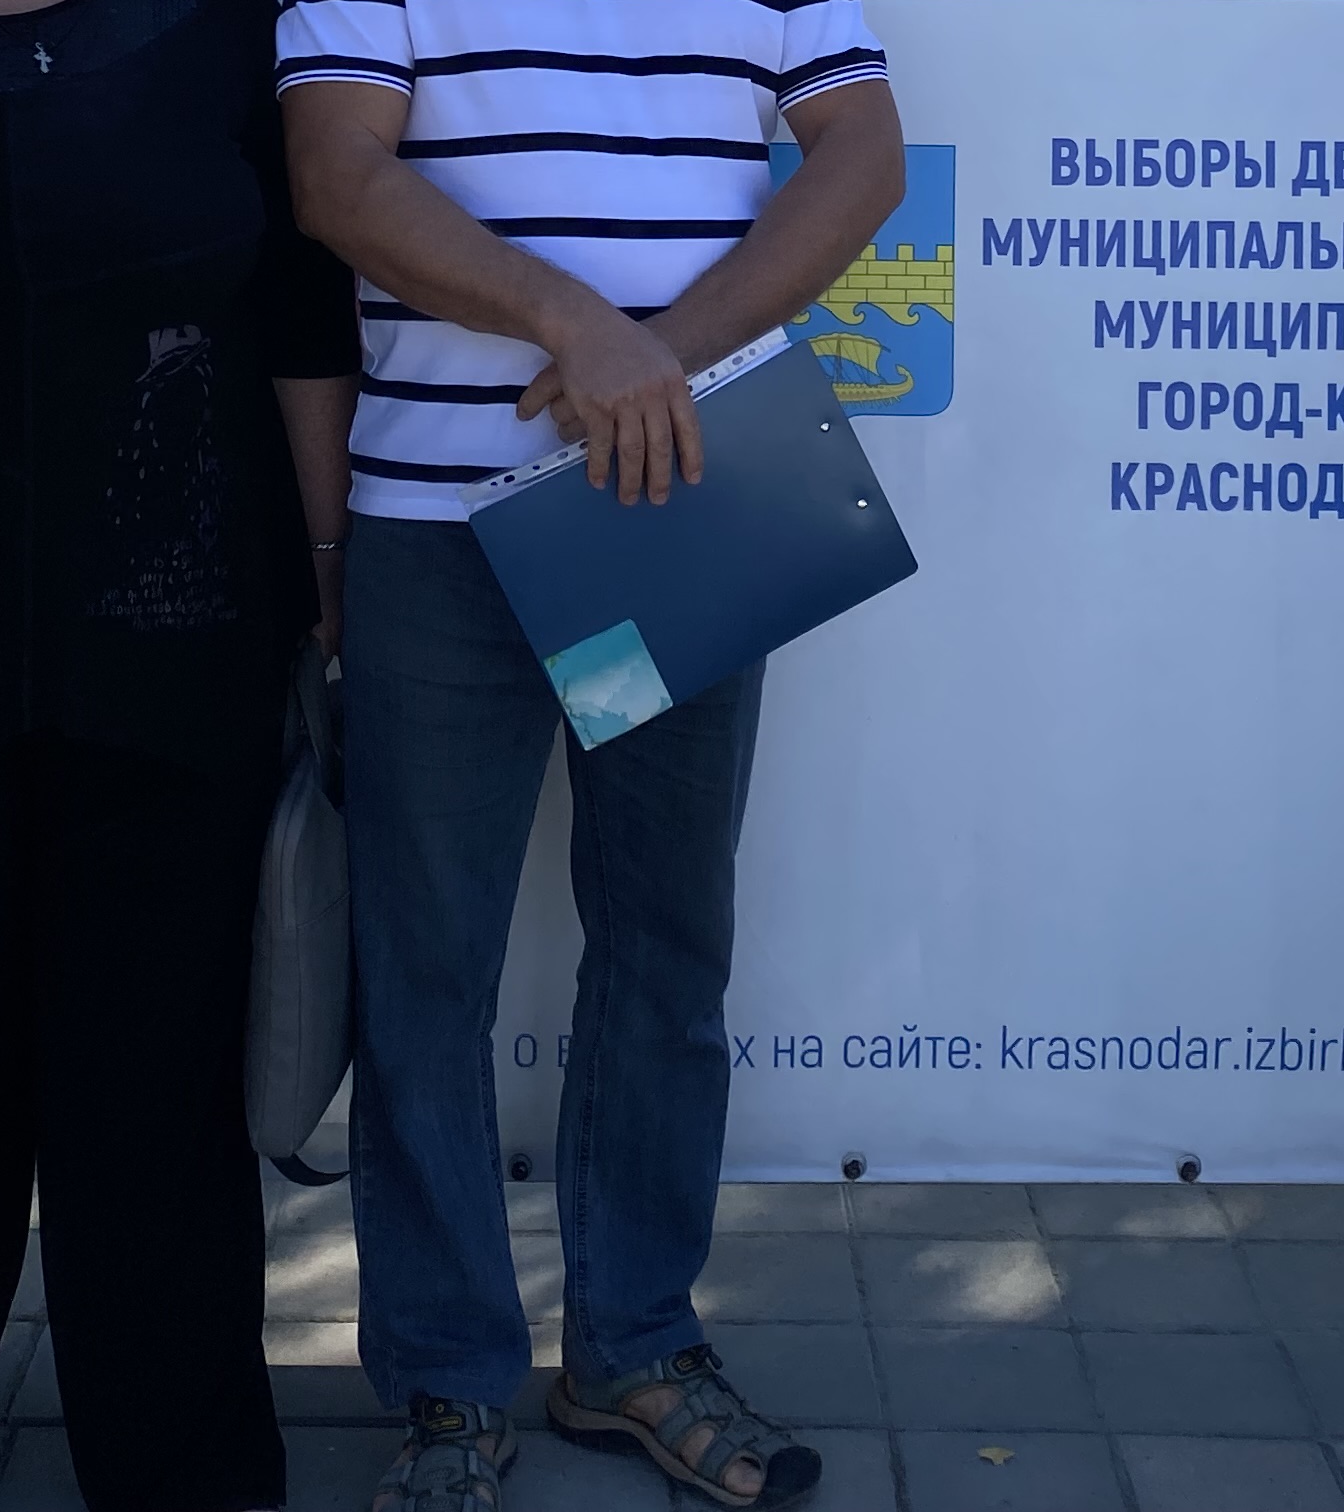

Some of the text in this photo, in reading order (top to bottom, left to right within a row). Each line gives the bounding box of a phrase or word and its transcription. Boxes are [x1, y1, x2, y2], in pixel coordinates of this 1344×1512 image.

[1051, 137, 1276, 189] ВЫБОРЫ
[773, 1035, 823, 1069] на
[843, 1024, 982, 1070] сайте:
